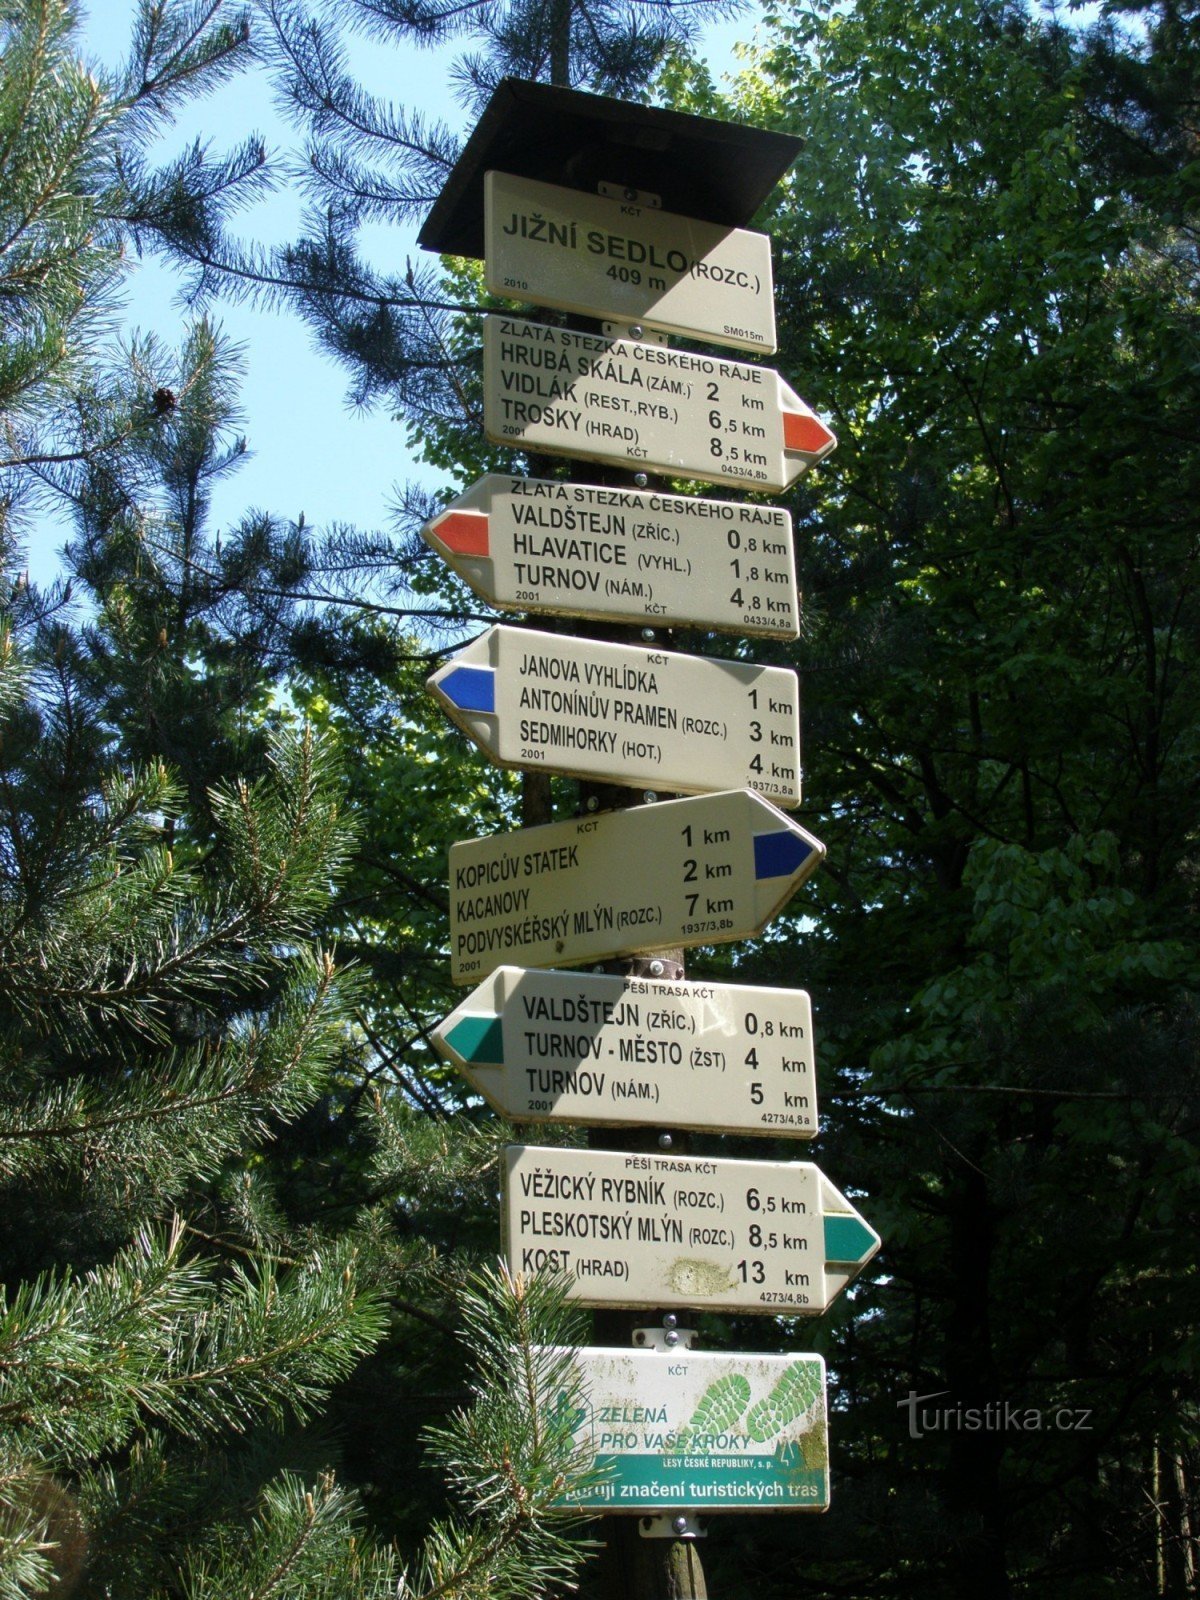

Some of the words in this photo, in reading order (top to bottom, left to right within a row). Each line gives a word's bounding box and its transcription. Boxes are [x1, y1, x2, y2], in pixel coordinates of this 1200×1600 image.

[620, 204, 642, 217] KČT
[503, 213, 577, 249] JIŽNÍ
[587, 231, 687, 272] SEDLO
[690, 260, 761, 294] (ROZC.)
[504, 278, 528, 290] 2010
[606, 264, 642, 286] 409
[648, 276, 666, 291] m
[723, 325, 764, 342] SM015m
[500, 321, 555, 343] ZLATÁ
[561, 333, 628, 357] STEZKA
[633, 346, 714, 374] ČESKÉHO
[719, 363, 762, 384] RÁJE
[501, 341, 571, 373] HRUBÁ
[578, 356, 643, 388] SKÁLA
[646, 375, 691, 399] (ZÁM.)
[707, 382, 720, 401] 2
[741, 394, 764, 411] km
[501, 368, 578, 403] VIDLÁK
[584, 391, 679, 424] (REST.,RYB.)
[708, 410, 737, 434] 6,5
[742, 421, 765, 438] km
[501, 399, 582, 432] TROSKY
[586, 419, 639, 445] (HRAD)
[710, 438, 739, 461] 8,5
[743, 449, 767, 466] km
[502, 425, 526, 437] 2001
[626, 446, 648, 458] KČT
[721, 465, 768, 480] 0433/4,8b
[511, 480, 568, 500] ZLATÁ
[574, 488, 644, 510] STEZKA
[650, 495, 734, 521] ČESKÉHO
[740, 508, 784, 527] RÁJE
[511, 503, 626, 537] VALDŠTEJN
[632, 522, 680, 545] (ZŘÍC.)
[727, 529, 757, 553] 0,8
[763, 539, 787, 555] km
[513, 533, 627, 566] HLAVATICE
[638, 553, 691, 576] (VYHL.)
[730, 559, 759, 582] 1,8
[765, 568, 789, 584] km
[513, 563, 600, 592] TURNOV
[605, 579, 653, 600] (NÁM.)
[730, 587, 760, 612] 4,8
[767, 597, 791, 613] km
[515, 591, 540, 601] 2001
[645, 602, 667, 614] KČT
[743, 615, 791, 629] 0433/4,8a
[647, 654, 669, 666] KČT
[520, 654, 580, 683] JANOVA
[585, 664, 658, 694] VYHLÍDKA
[748, 689, 757, 709] 1
[769, 698, 793, 715] km
[520, 687, 609, 719] ANTONÍNŮV
[614, 701, 678, 730] PRAMEN
[682, 717, 727, 741] (ROZC.)
[749, 721, 762, 742] 3
[770, 731, 794, 747] km
[520, 720, 617, 753] SEDMIHORKY
[622, 741, 662, 763] (HOT.)
[749, 754, 763, 775] 4
[771, 764, 795, 780] km
[521, 749, 545, 761] 2001
[747, 781, 793, 795] 1937/3,8a
[456, 853, 519, 890] KOPICŮV
[523, 845, 579, 876] STATEK
[682, 825, 692, 847] 1
[703, 829, 730, 845] km
[457, 888, 530, 923] KACANOVY
[683, 860, 698, 883] 2
[706, 863, 732, 880] km
[458, 909, 569, 956] PODVYSKÉŘSKÝ
[574, 906, 614, 935] MLÝN
[617, 906, 662, 931] (ROZC.)
[685, 893, 700, 917] 7
[706, 897, 734, 914] km
[681, 918, 733, 935] 1937/3,8b
[459, 960, 481, 973] 2001
[623, 982, 649, 994] PĚŠÍ
[652, 985, 689, 997] TRASA
[693, 987, 715, 999] KČT
[522, 994, 640, 1027] VALDŠTEJN
[646, 1011, 696, 1034] (ZŘÍC.)
[744, 1012, 774, 1039] 0,8
[779, 1021, 804, 1039] km
[524, 1032, 602, 1060] TURNOV
[619, 1034, 682, 1065] MĚSTO
[689, 1048, 726, 1072] (ŽST)
[744, 1048, 759, 1070] 4
[782, 1056, 806, 1073] km
[526, 1068, 605, 1096] TURNOV
[611, 1080, 660, 1104] (NÁM.)
[750, 1083, 764, 1105] 5
[784, 1092, 809, 1109] km
[528, 1100, 553, 1111] 2001
[761, 1113, 810, 1126] 4273/4,8a
[625, 1155, 651, 1170] PĚŠÍ
[654, 1160, 692, 1173] TRASA
[695, 1161, 717, 1175] KČT
[520, 1168, 595, 1201] VĚŽICKÝ
[602, 1175, 666, 1206] RYBNÍK
[673, 1189, 724, 1213] (ROZC.)
[746, 1188, 776, 1214] 6,5
[781, 1197, 806, 1214] km
[521, 1210, 632, 1237] PLESKOTSKÝ
[638, 1213, 683, 1243] MLÝN
[688, 1227, 735, 1250] (ROZC.)
[749, 1224, 777, 1250] 8,5
[783, 1234, 808, 1250] km
[522, 1248, 570, 1273] KOST
[576, 1258, 629, 1282] (HRAD)
[737, 1259, 766, 1284] 13
[785, 1269, 809, 1286] km
[759, 1292, 809, 1304] 4273/4,8b
[668, 1365, 688, 1376] KČT
[599, 1404, 668, 1423] ZELENÁ
[600, 1433, 637, 1449] PRO
[643, 1429, 686, 1449] VAŠE
[691, 1433, 751, 1450] KROKY
[663, 1458, 682, 1468] LESY
[684, 1456, 709, 1468] ČESKÉ
[711, 1459, 756, 1470] REPUBLIKY,
[620, 1480, 685, 1498] značení
[690, 1480, 784, 1501] turistických
[788, 1482, 818, 1497] tras
